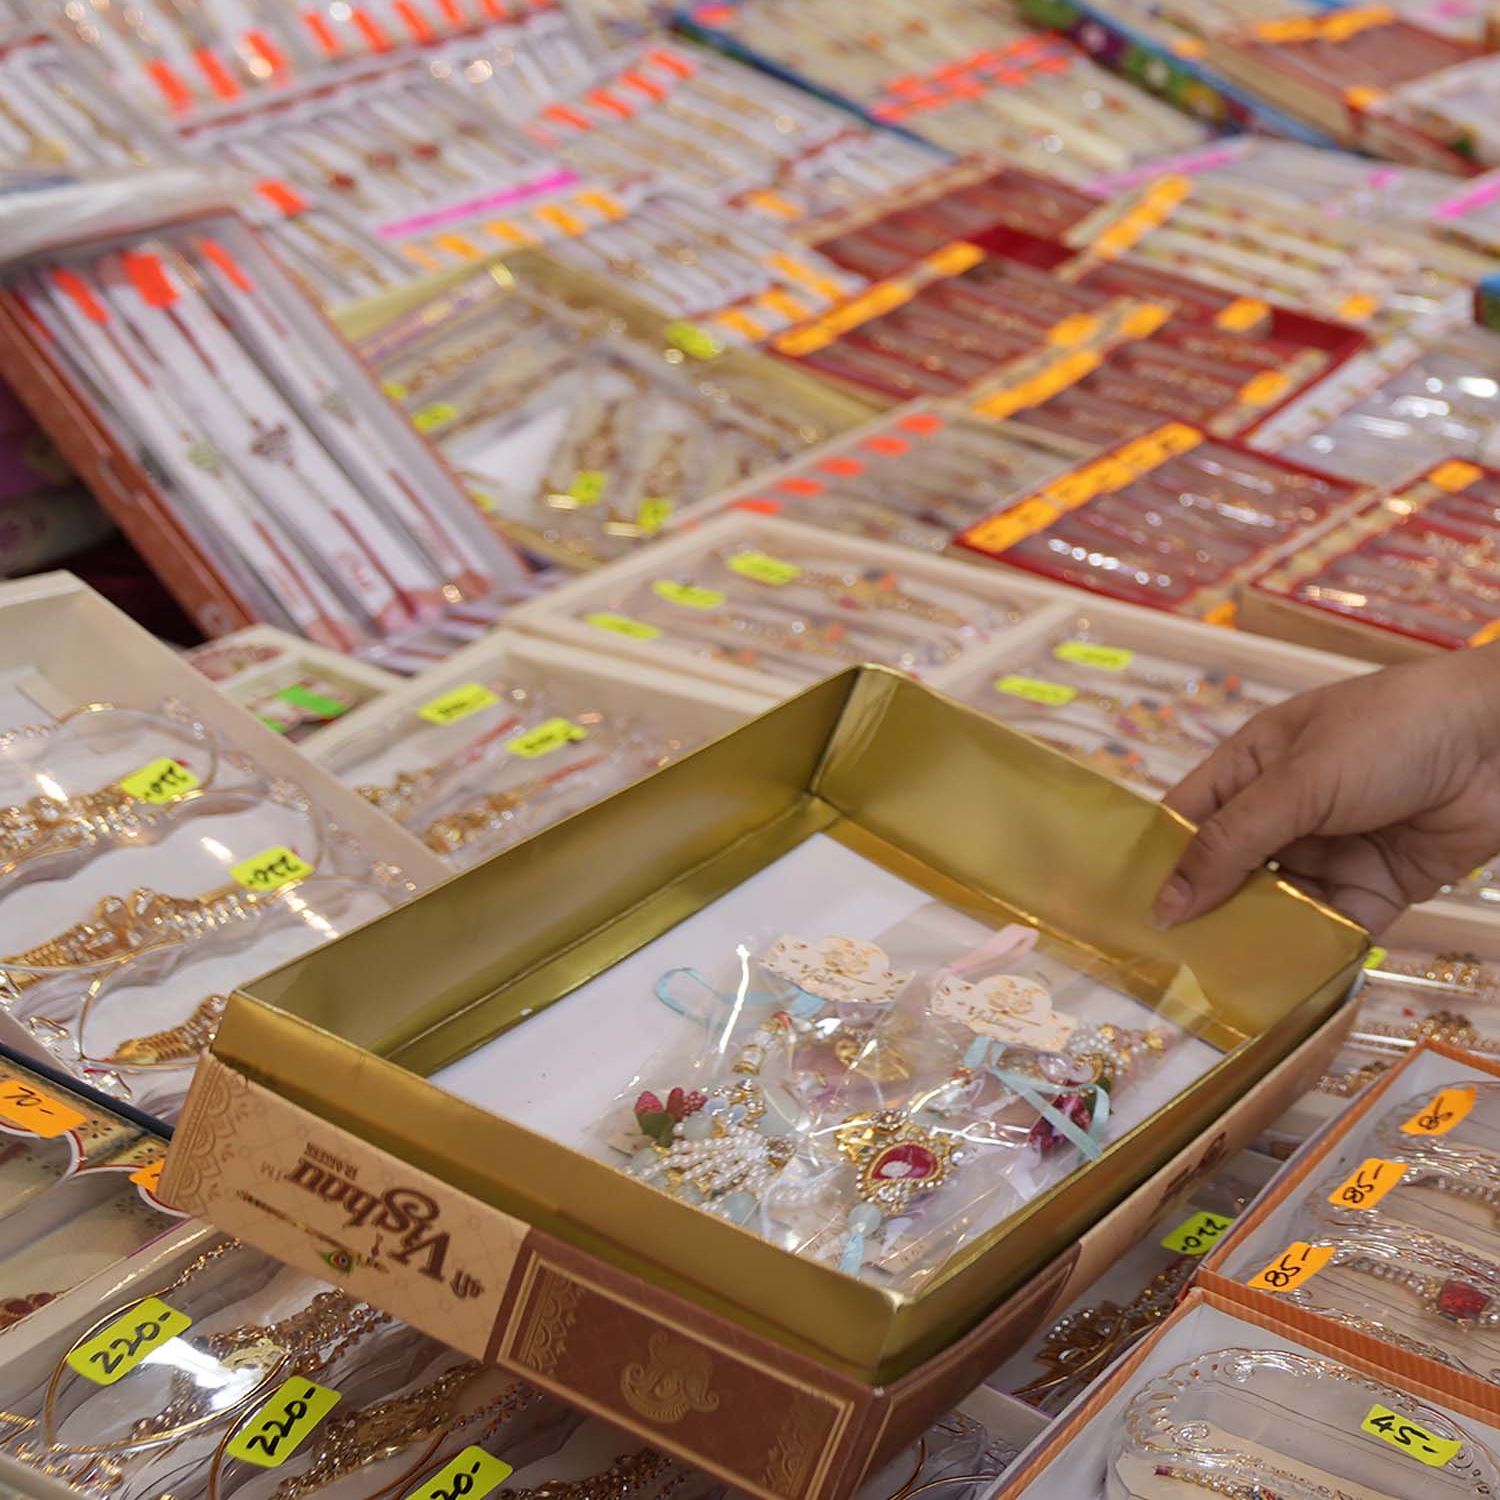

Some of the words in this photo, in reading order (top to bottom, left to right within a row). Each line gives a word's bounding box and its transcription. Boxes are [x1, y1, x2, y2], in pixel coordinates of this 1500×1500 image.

[1342, 1164, 1384, 1204] 85-
[286, 1156, 450, 1283] Vishnu
[1265, 1248, 1312, 1288] 85-
[92, 1308, 173, 1379] 220-
[247, 1387, 317, 1468] 220-
[1371, 1414, 1438, 1454] 45-
